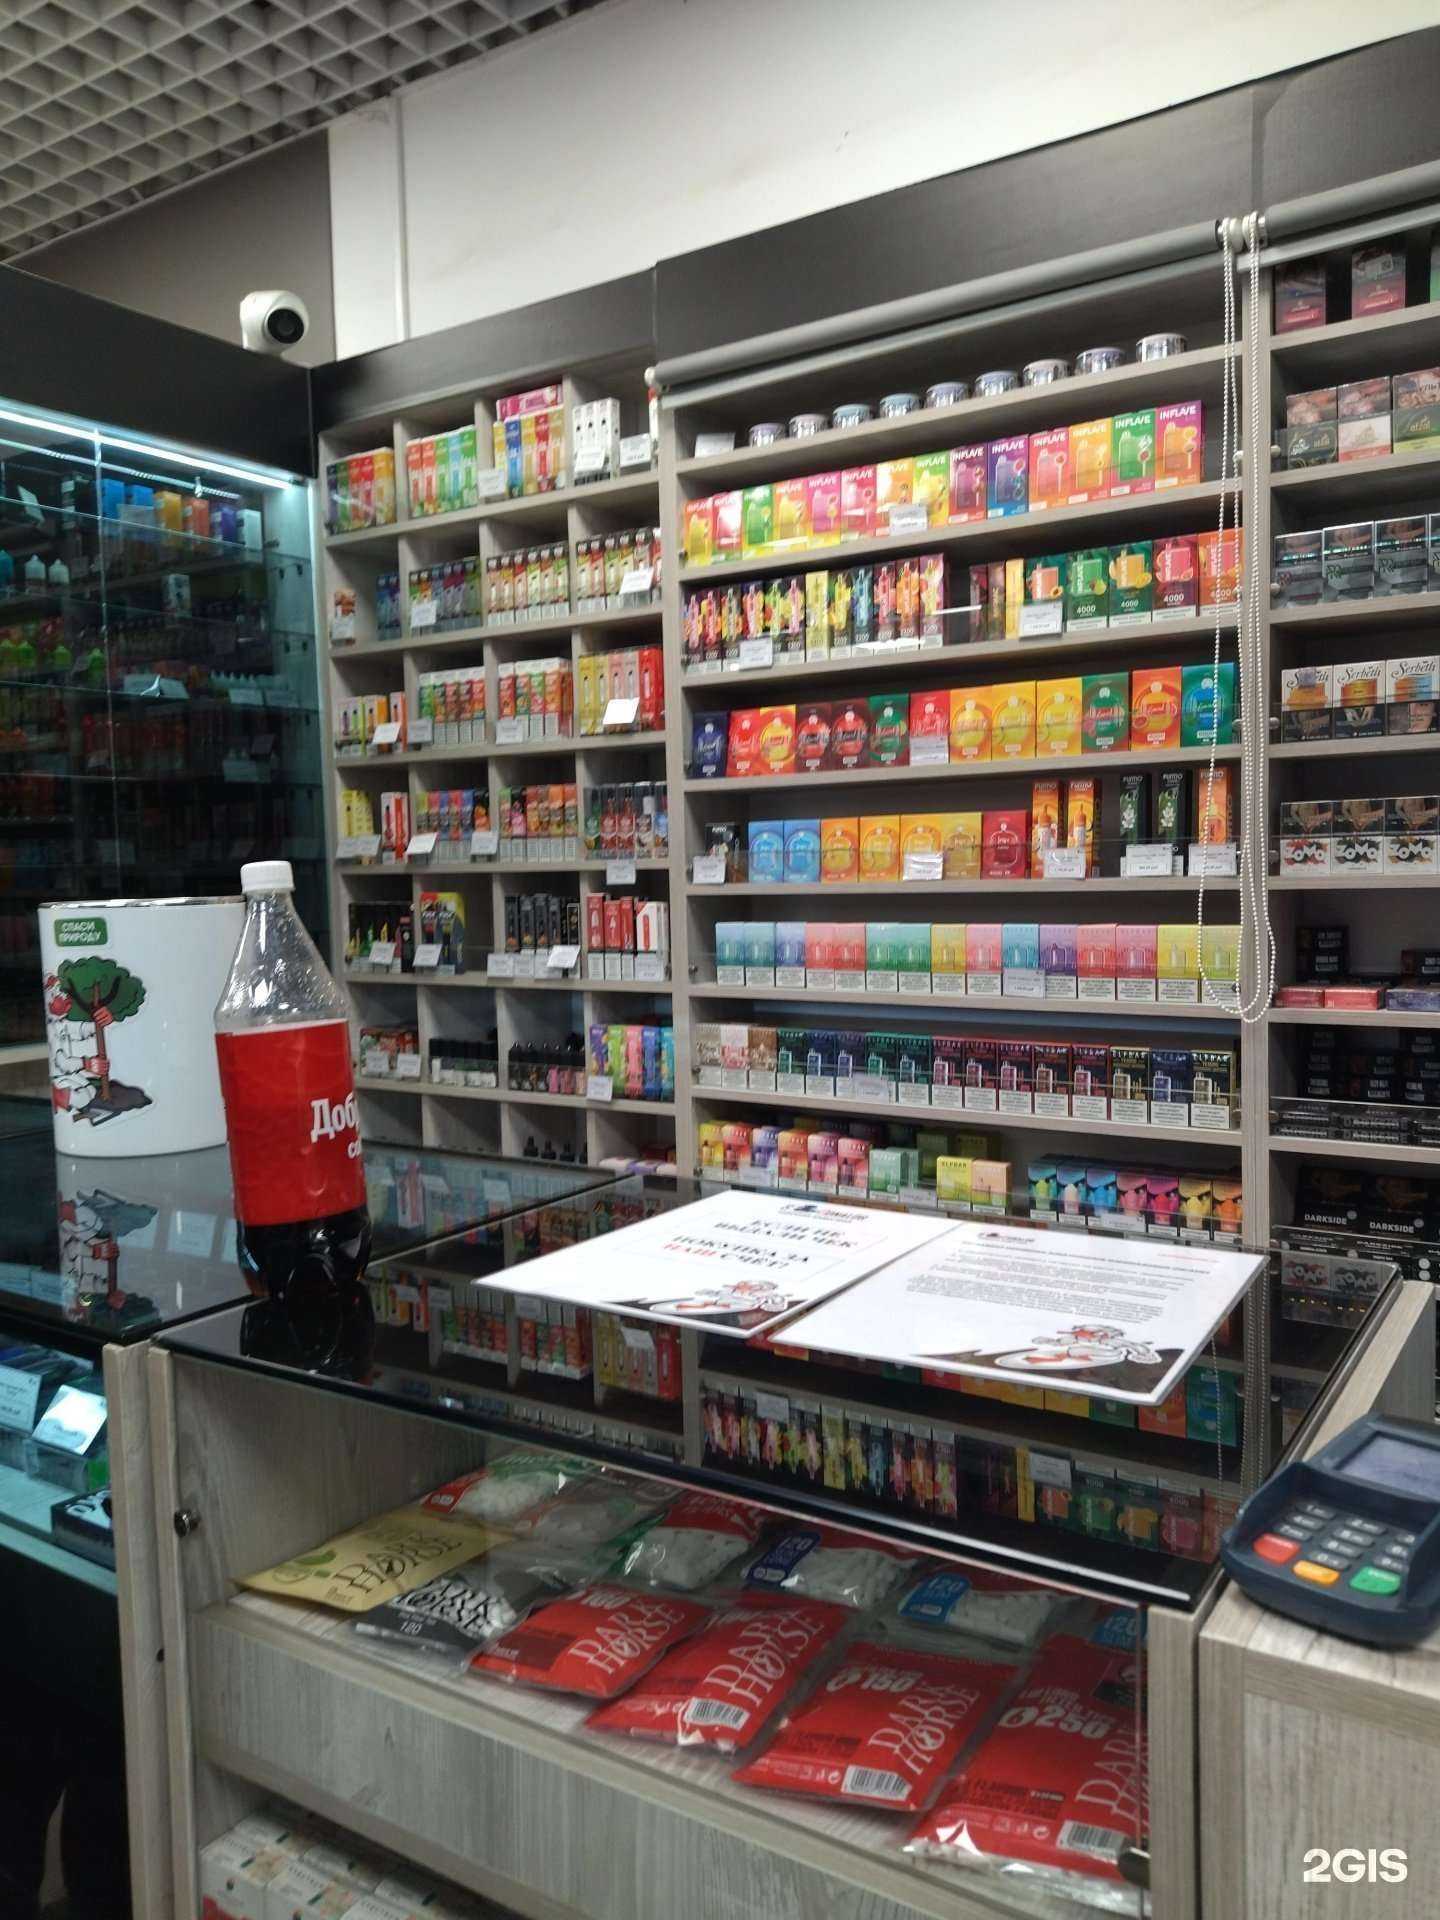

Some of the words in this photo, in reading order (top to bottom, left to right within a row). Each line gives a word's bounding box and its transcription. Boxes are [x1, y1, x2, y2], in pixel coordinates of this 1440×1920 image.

[1120, 599, 1140, 609] 4000
[1163, 593, 1185, 603] 4000
[1076, 604, 1097, 615] 4000
[941, 1161, 967, 1169] ELFBAR
[1305, 1213, 1348, 1226] DARKSIDE
[1369, 1221, 1414, 1234] DARKSIDE
[586, 1603, 685, 1676] HORSE
[728, 1611, 825, 1708] HORSE
[1035, 1705, 1112, 1740] 250
[893, 1688, 981, 1776] HORSE
